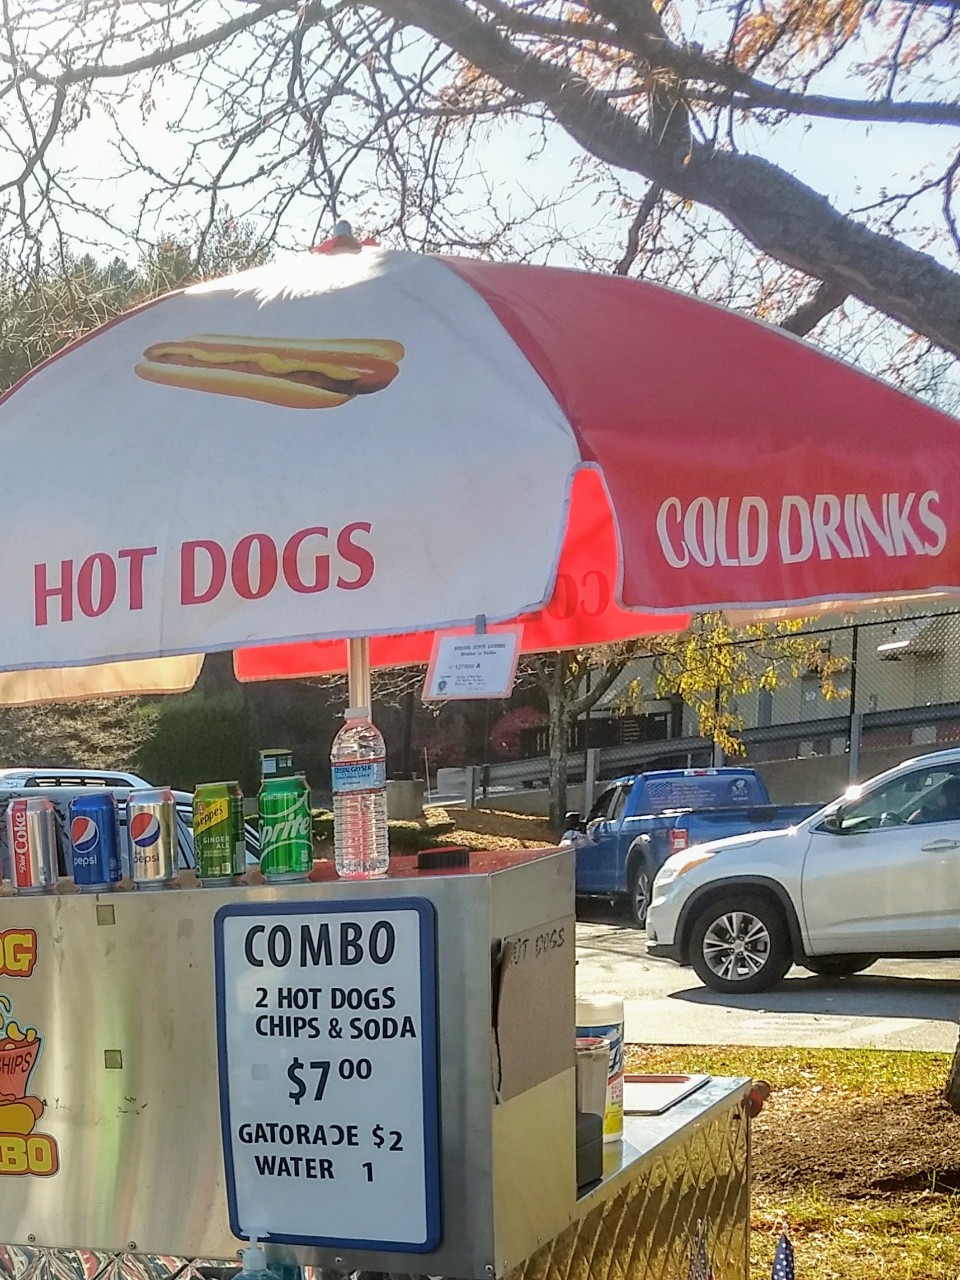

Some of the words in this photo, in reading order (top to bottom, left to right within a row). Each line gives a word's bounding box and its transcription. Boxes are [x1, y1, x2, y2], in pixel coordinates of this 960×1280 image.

[656, 496, 768, 568] COLD
[779, 490, 947, 563] DRINKS
[34, 546, 158, 626] HOT
[180, 522, 375, 605] DOGS
[15, 811, 29, 854] Coke
[202, 836, 230, 844] GINGER
[74, 855, 98, 868] pepsi
[133, 853, 160, 866] pepsi
[244, 920, 396, 968] COMBO
[255, 987, 269, 1009] 2
[278, 987, 322, 1010] HOT
[331, 986, 396, 1010] DOGS
[255, 1015, 321, 1039] CHIPS
[328, 1018, 343, 1039] &
[350, 1015, 417, 1041] SODA
[254, 1155, 335, 1180] WATER
[362, 1161, 374, 1183] 1
